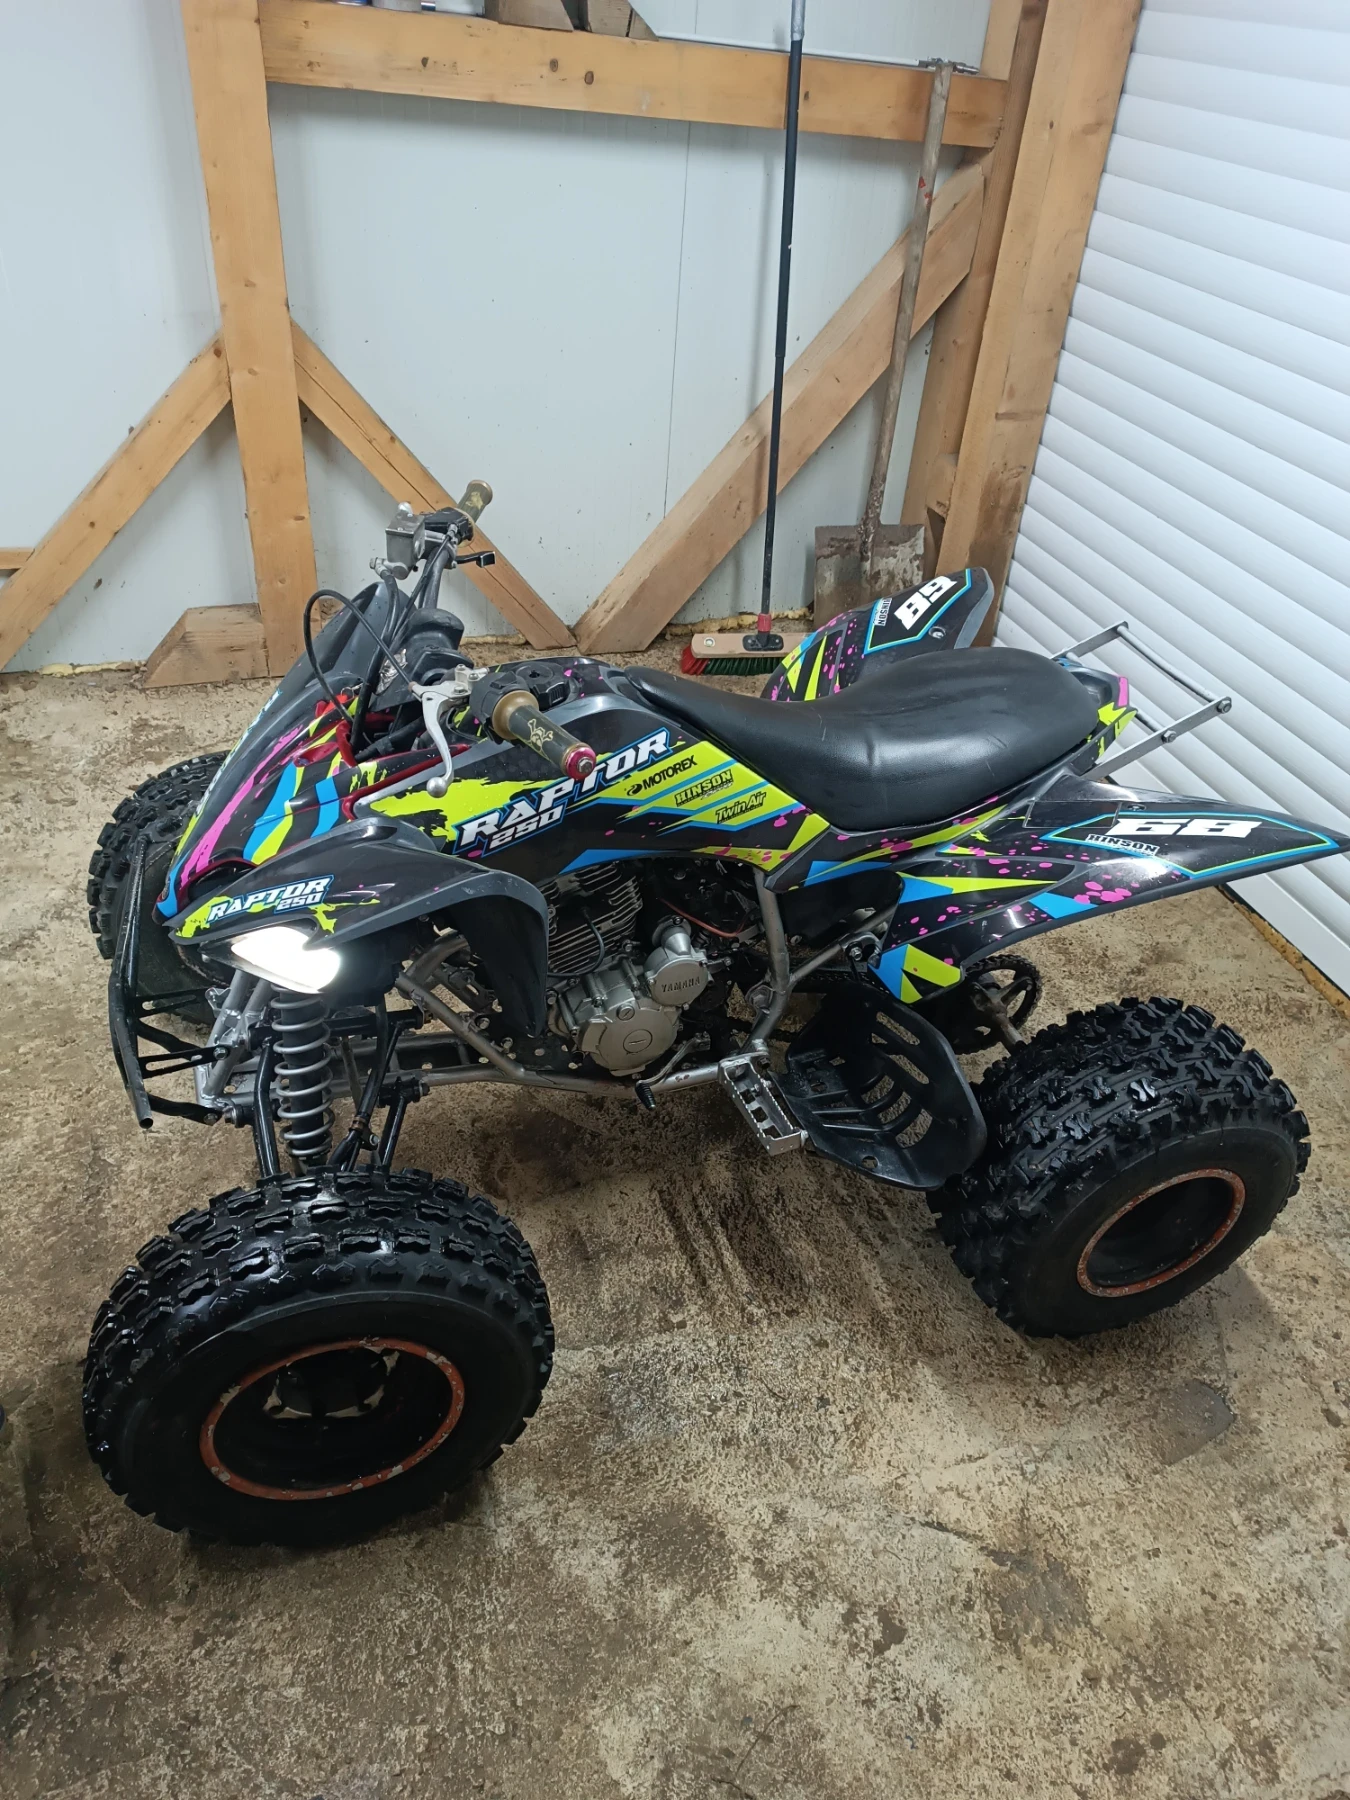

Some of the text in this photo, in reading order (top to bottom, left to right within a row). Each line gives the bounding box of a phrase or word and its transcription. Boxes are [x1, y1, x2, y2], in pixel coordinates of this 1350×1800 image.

[460, 729, 668, 847] RAPTOR
[641, 755, 698, 790] MOTOREX
[674, 769, 734, 806] HINSON
[715, 801, 746, 823] Twin
[746, 792, 767, 809] Air
[489, 806, 563, 850] 250
[1087, 834, 1160, 855] HINSON
[1105, 818, 1263, 839] 68
[207, 877, 331, 921] RAPTOR
[276, 892, 321, 911] 250
[661, 976, 700, 993] YAMAHA
